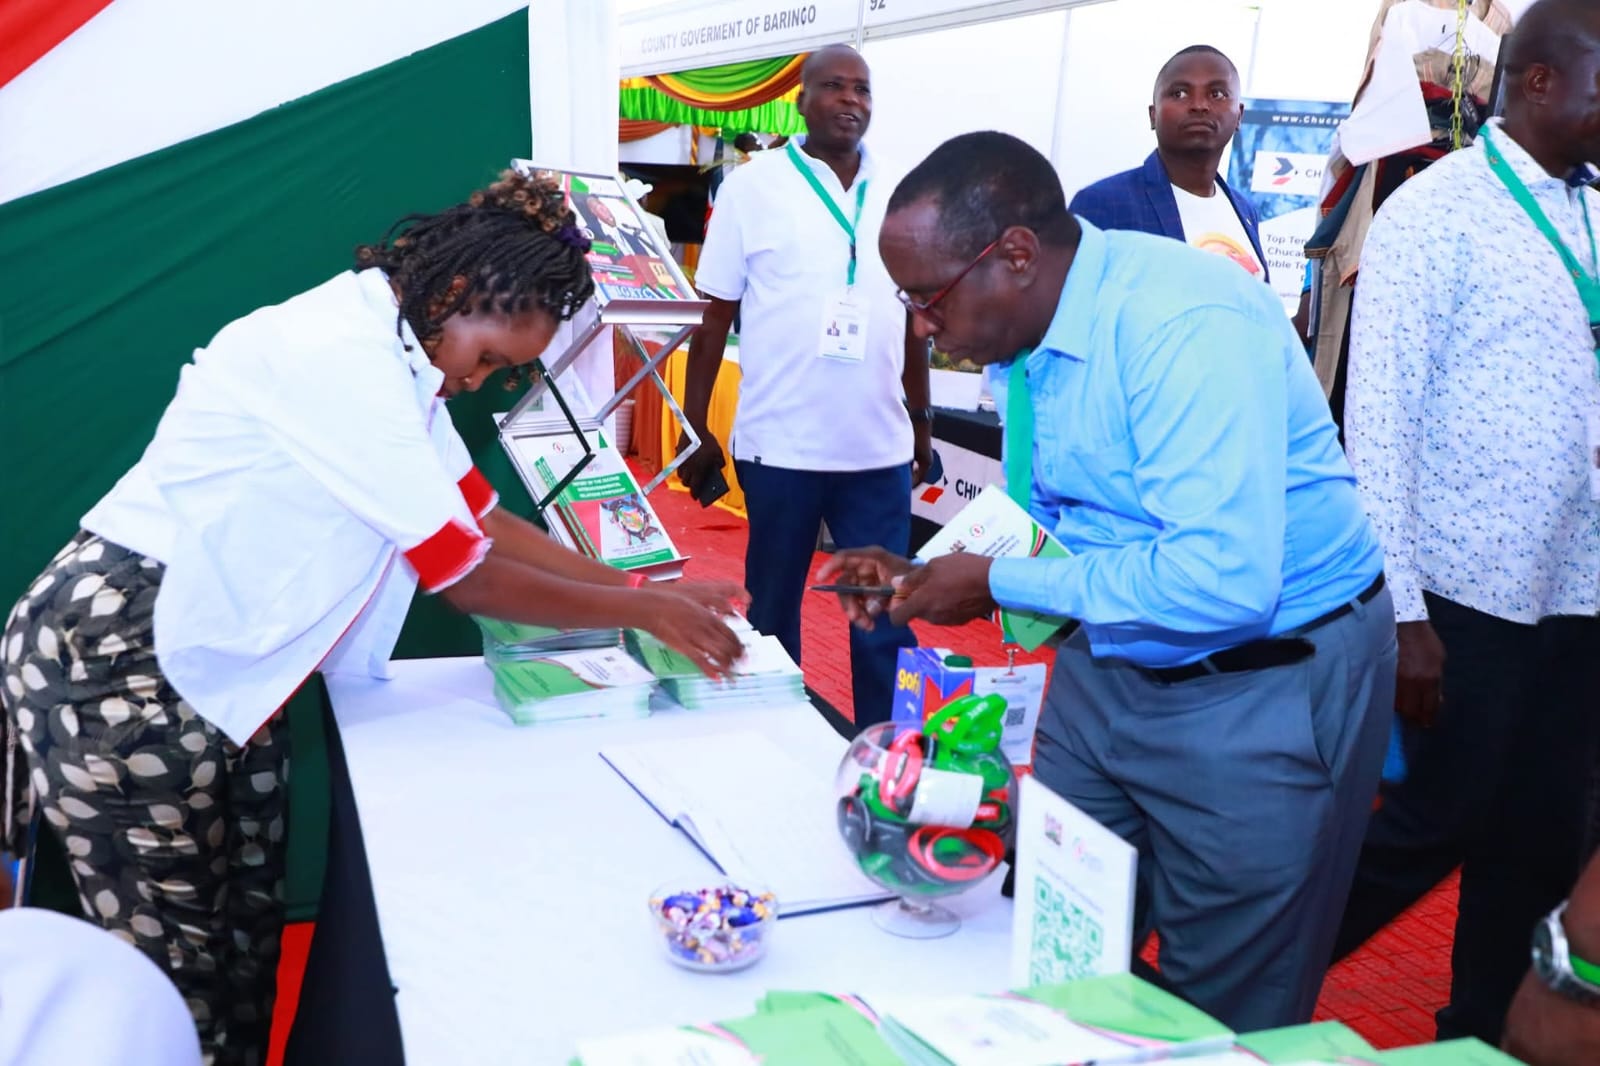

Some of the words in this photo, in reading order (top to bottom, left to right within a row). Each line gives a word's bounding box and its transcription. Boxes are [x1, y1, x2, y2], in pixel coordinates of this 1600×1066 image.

[641, 32, 678, 54] COUNTY
[681, 20, 743, 47] GOVERMENT
[746, 17, 760, 36] OF
[764, 5, 817, 32] BARINGO
[1267, 234, 1286, 244] Top
